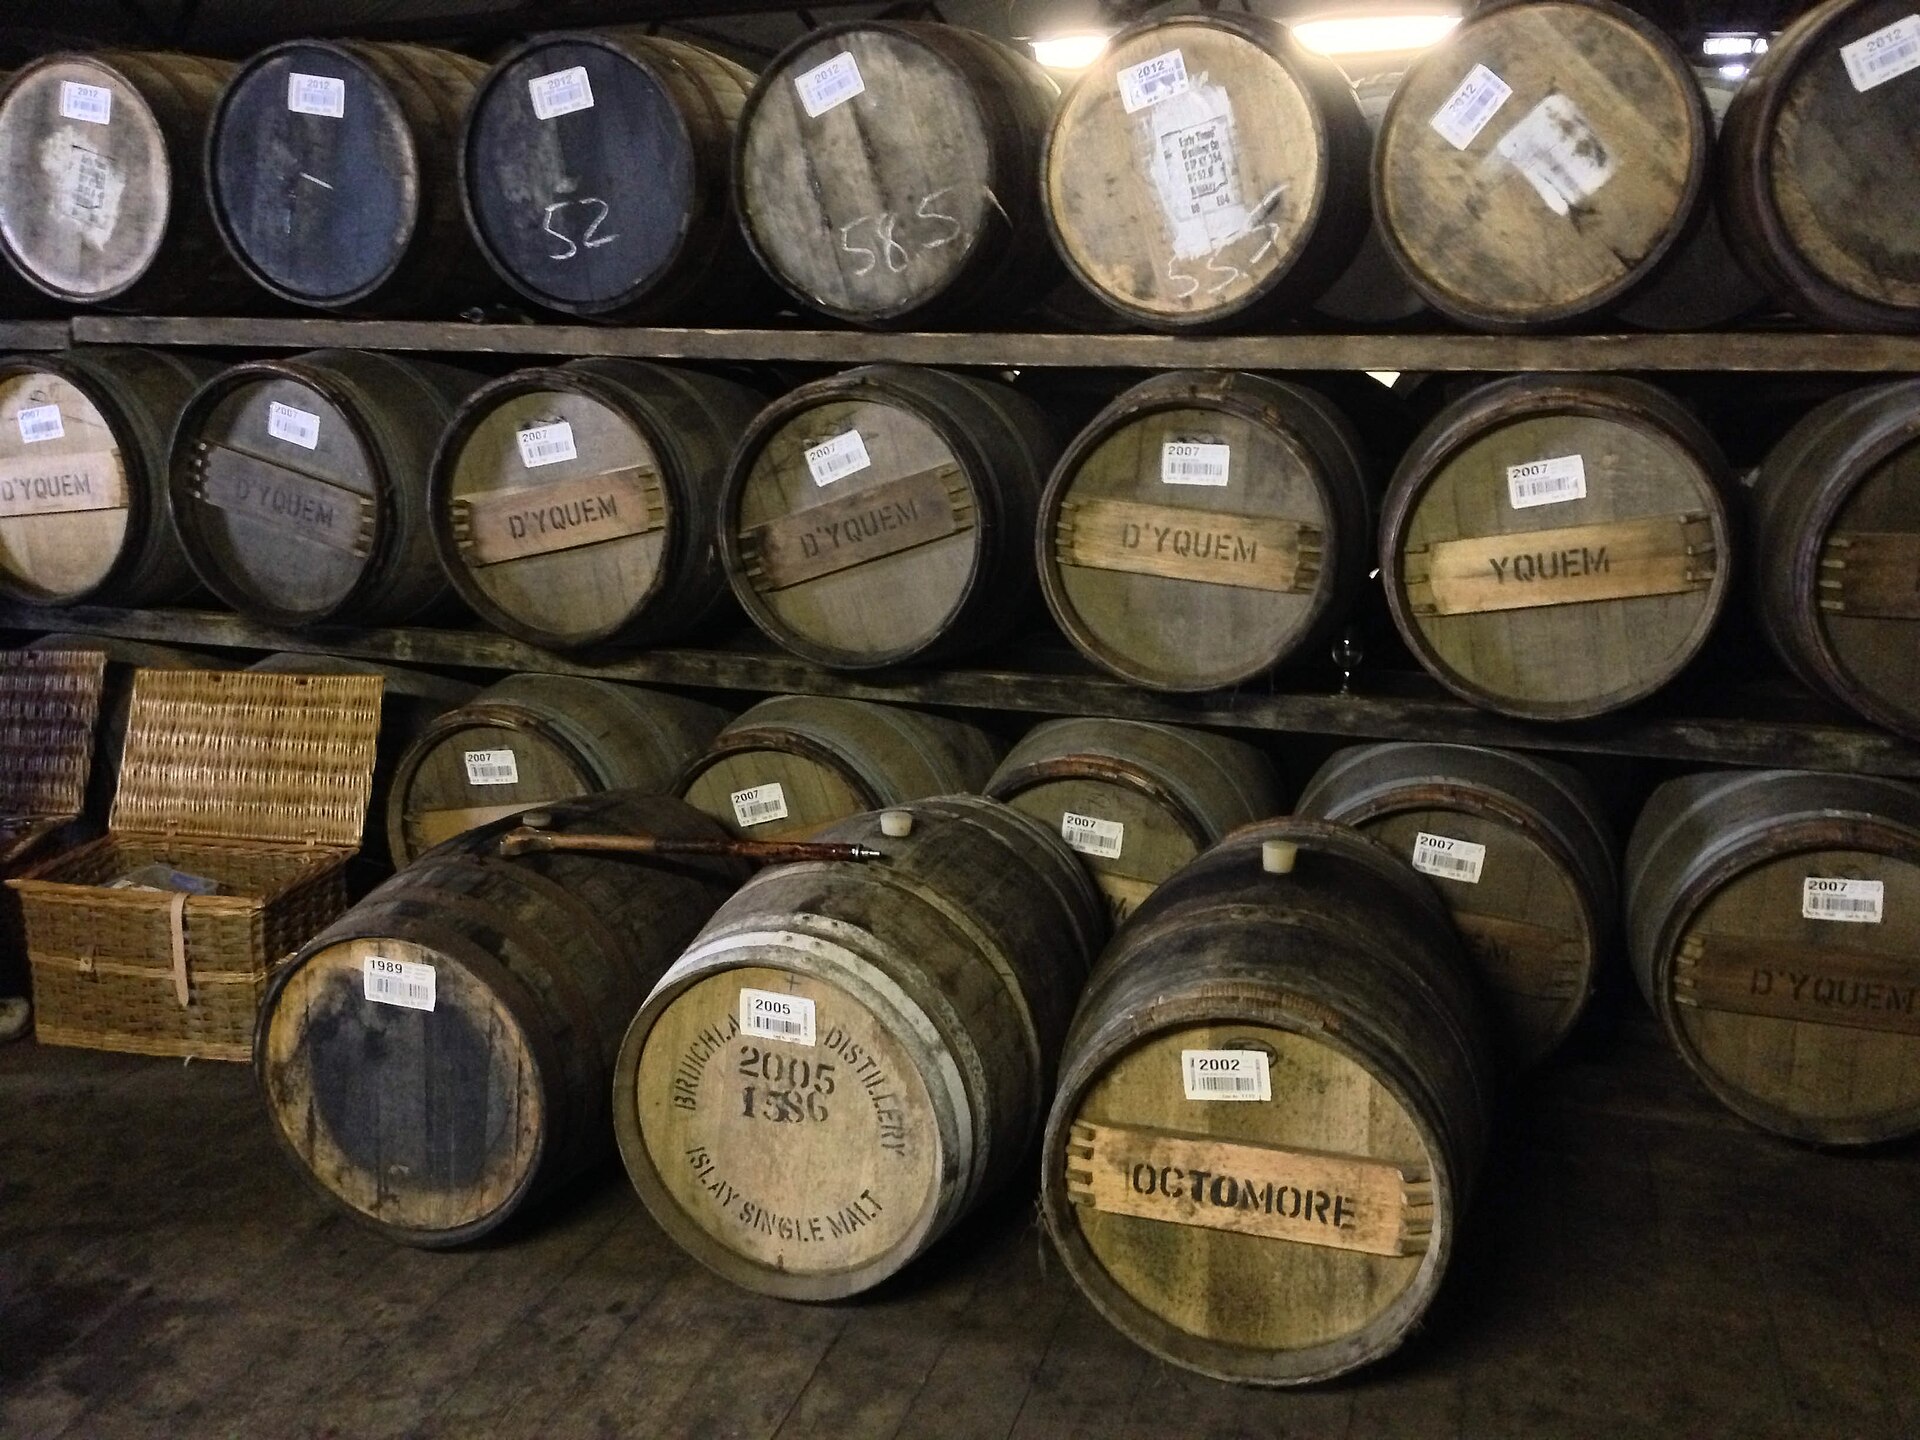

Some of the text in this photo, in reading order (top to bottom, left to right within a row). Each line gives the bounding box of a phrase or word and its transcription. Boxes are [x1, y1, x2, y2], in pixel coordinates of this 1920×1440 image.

[1866, 29, 1902, 52] 2012
[813, 64, 841, 84] 2012
[1136, 60, 1165, 79] 2012
[307, 79, 331, 90] 2012
[546, 75, 573, 90] 2012
[77, 87, 99, 98] 2012
[543, 198, 620, 260] 52
[20, 410, 40, 420] 2007
[274, 405, 298, 419] 2007
[522, 429, 548, 443] 2007
[810, 443, 835, 461] 2007
[1168, 445, 1200, 457] 2007
[1512, 463, 1548, 479] 2007
[1, 473, 91, 501] D'YQUEM
[508, 493, 618, 539] D'YQUEM
[800, 498, 919, 558] D'YQUEM
[1122, 522, 1258, 563] D'YQUEM
[1489, 546, 1610, 585] YQUEM
[467, 753, 491, 762] 2007
[734, 789, 758, 803] 2007
[1066, 815, 1096, 828] 2007
[1420, 836, 1454, 851] 2007
[1808, 880, 1848, 892] 2007
[371, 959, 403, 974] 1989
[1751, 968, 1916, 1015] D'YQUEM
[755, 998, 791, 1015] 2005
[738, 1045, 836, 1095] 2005
[1199, 1058, 1240, 1071] 2002
[674, 1013, 906, 1157] BRUICHLA DISTILLERY
[686, 1146, 884, 1242] ISLAY SINGLE MALT
[1132, 1162, 1356, 1230] OCTOMORE
